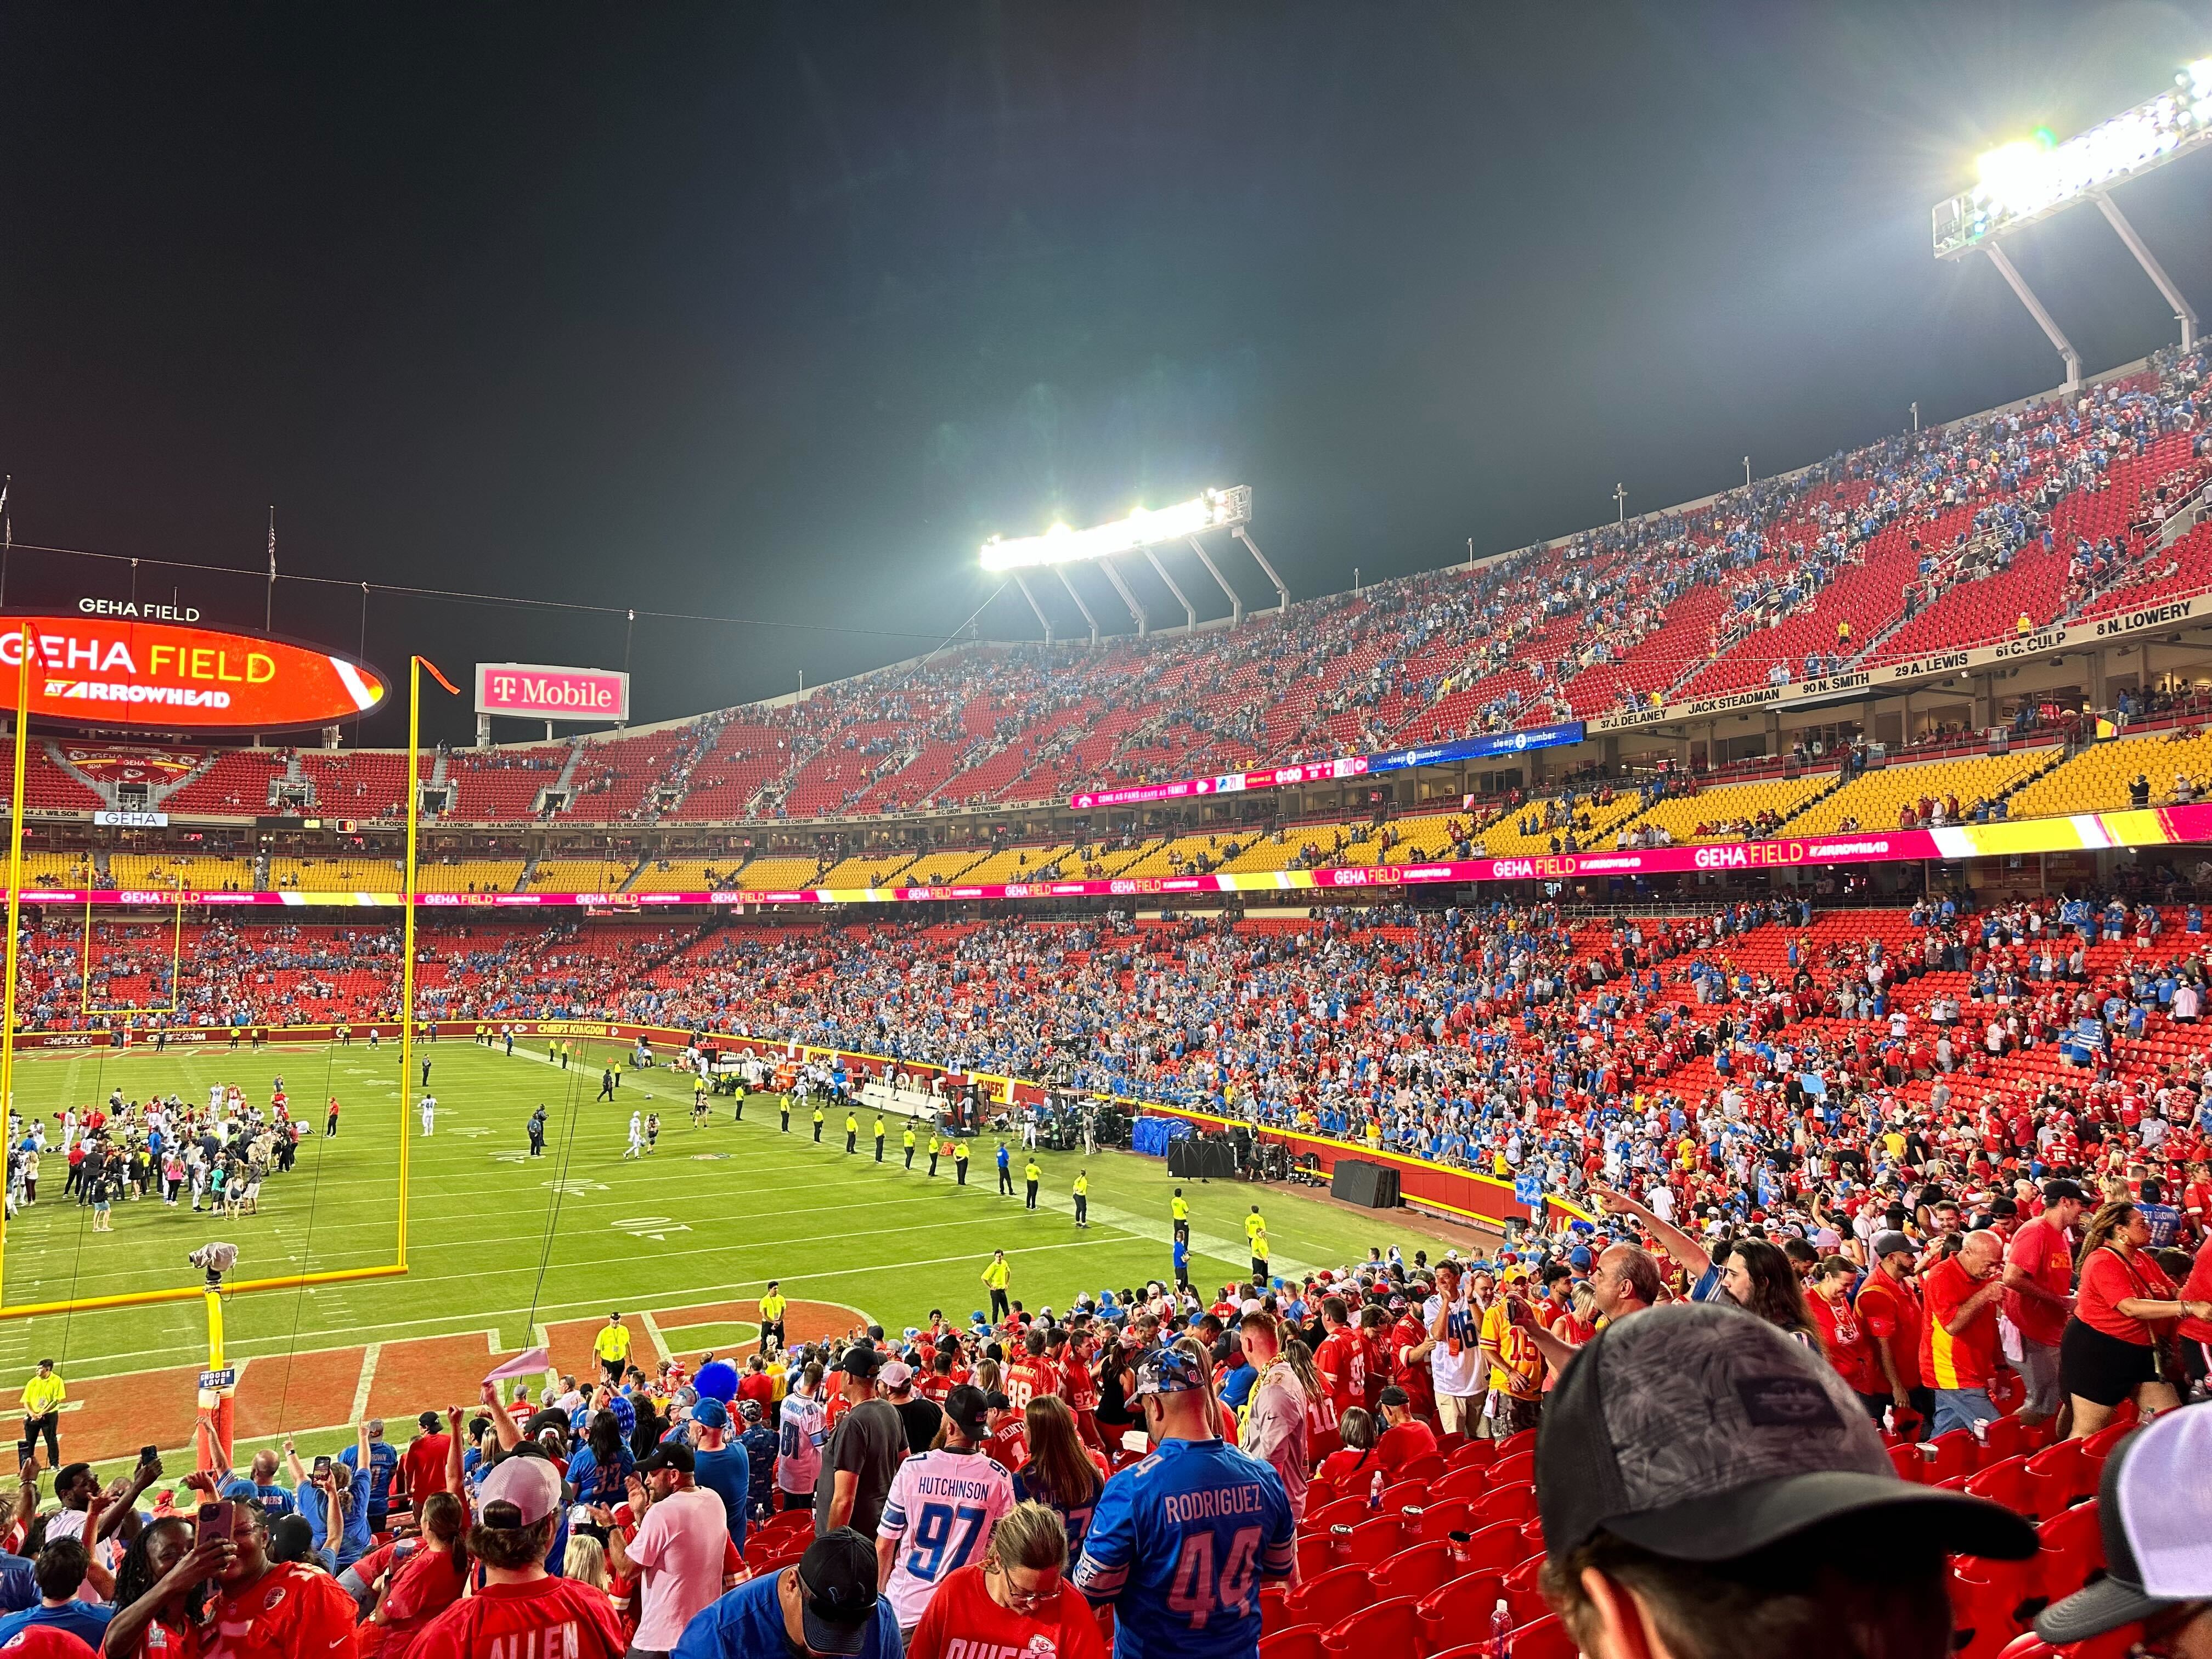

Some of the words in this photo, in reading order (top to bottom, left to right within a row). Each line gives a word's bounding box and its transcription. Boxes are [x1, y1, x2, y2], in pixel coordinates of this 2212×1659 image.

[79, 598, 138, 617] GEHA
[144, 604, 200, 622] FIELD
[2097, 623, 2104, 635] 8
[2107, 619, 2121, 633] N.
[2125, 601, 2191, 629] LOWERY
[1996, 645, 2010, 657] 61
[2012, 642, 2024, 655] C.
[2026, 632, 2066, 651] CULP
[0, 632, 137, 674] GEHA
[150, 645, 275, 682] FIELD
[1895, 666, 1908, 677] 29
[1911, 662, 1923, 674] A.
[1926, 653, 1968, 671] LEWIS
[493, 676, 516, 702] T
[521, 678, 612, 707] Mobile
[1803, 682, 1816, 694] 90
[1818, 679, 1830, 692] N.
[1833, 673, 1869, 690] SMITH
[44, 682, 67, 694] AT
[63, 681, 230, 708] ARROWHEAD
[1688, 699, 1717, 714] JACK
[1719, 689, 1779, 710] STEADMAN
[1601, 720, 1611, 729] 37
[1611, 718, 1620, 727] J.
[1621, 709, 1667, 726] DELANEY
[1493, 739, 1513, 748] sleep
[1527, 732, 1556, 743] number
[1388, 755, 1406, 764] sleep
[1417, 750, 1441, 759] number
[1276, 768, 1302, 783] 0:00
[1343, 760, 1352, 774] 20
[1229, 777, 1236, 789] 21
[1098, 794, 1114, 803] COME
[1115, 793, 1123, 801] AS
[1125, 791, 1139, 800] FANS
[1167, 785, 1187, 795] FAMILY
[105, 812, 157, 825] GEHA
[1695, 848, 1747, 867] GEHA
[1751, 843, 1803, 864] FIELD
[1817, 842, 1888, 856] ARROWHEAD
[1334, 870, 1367, 884] GEHA
[1368, 868, 1400, 883] FIELD
[1493, 860, 1533, 877] GEHA
[1536, 857, 1576, 874] FIELD
[908, 890, 930, 899] GEHA
[930, 888, 951, 898] FIELD
[1005, 886, 1028, 896] GEHA
[1029, 885, 1051, 895] FIELD
[1110, 882, 1136, 893] GEHA
[1137, 880, 1161, 891] FIELD
[121, 893, 160, 903] GEHA
[425, 895, 459, 904] GEHA
[461, 895, 493, 904] FIELD
[576, 894, 607, 903] GEHA
[609, 894, 638, 902] FIELD
[711, 893, 737, 902] GEHA
[740, 893, 765, 902] FIELD
[537, 1024, 569, 1033] CHIEFS
[569, 1024, 606, 1036] KINGDOM
[977, 1079, 1005, 1097] CHIEFS
[200, 1371, 230, 1380] CHOOSE
[204, 1378, 225, 1386] LOVE
[1007, 1378, 1032, 1409] 88
[1074, 1391, 1092, 1406] 97
[781, 1420, 799, 1460] 81
[370, 1453, 387, 1462] ROWN
[918, 1476, 989, 1502] HUTCHINSON
[1165, 1484, 1262, 1523] RODRIGUEZ
[906, 1501, 988, 1583] 97
[1167, 1525, 1263, 1629] 44
[492, 1620, 579, 1659] ALLEN
